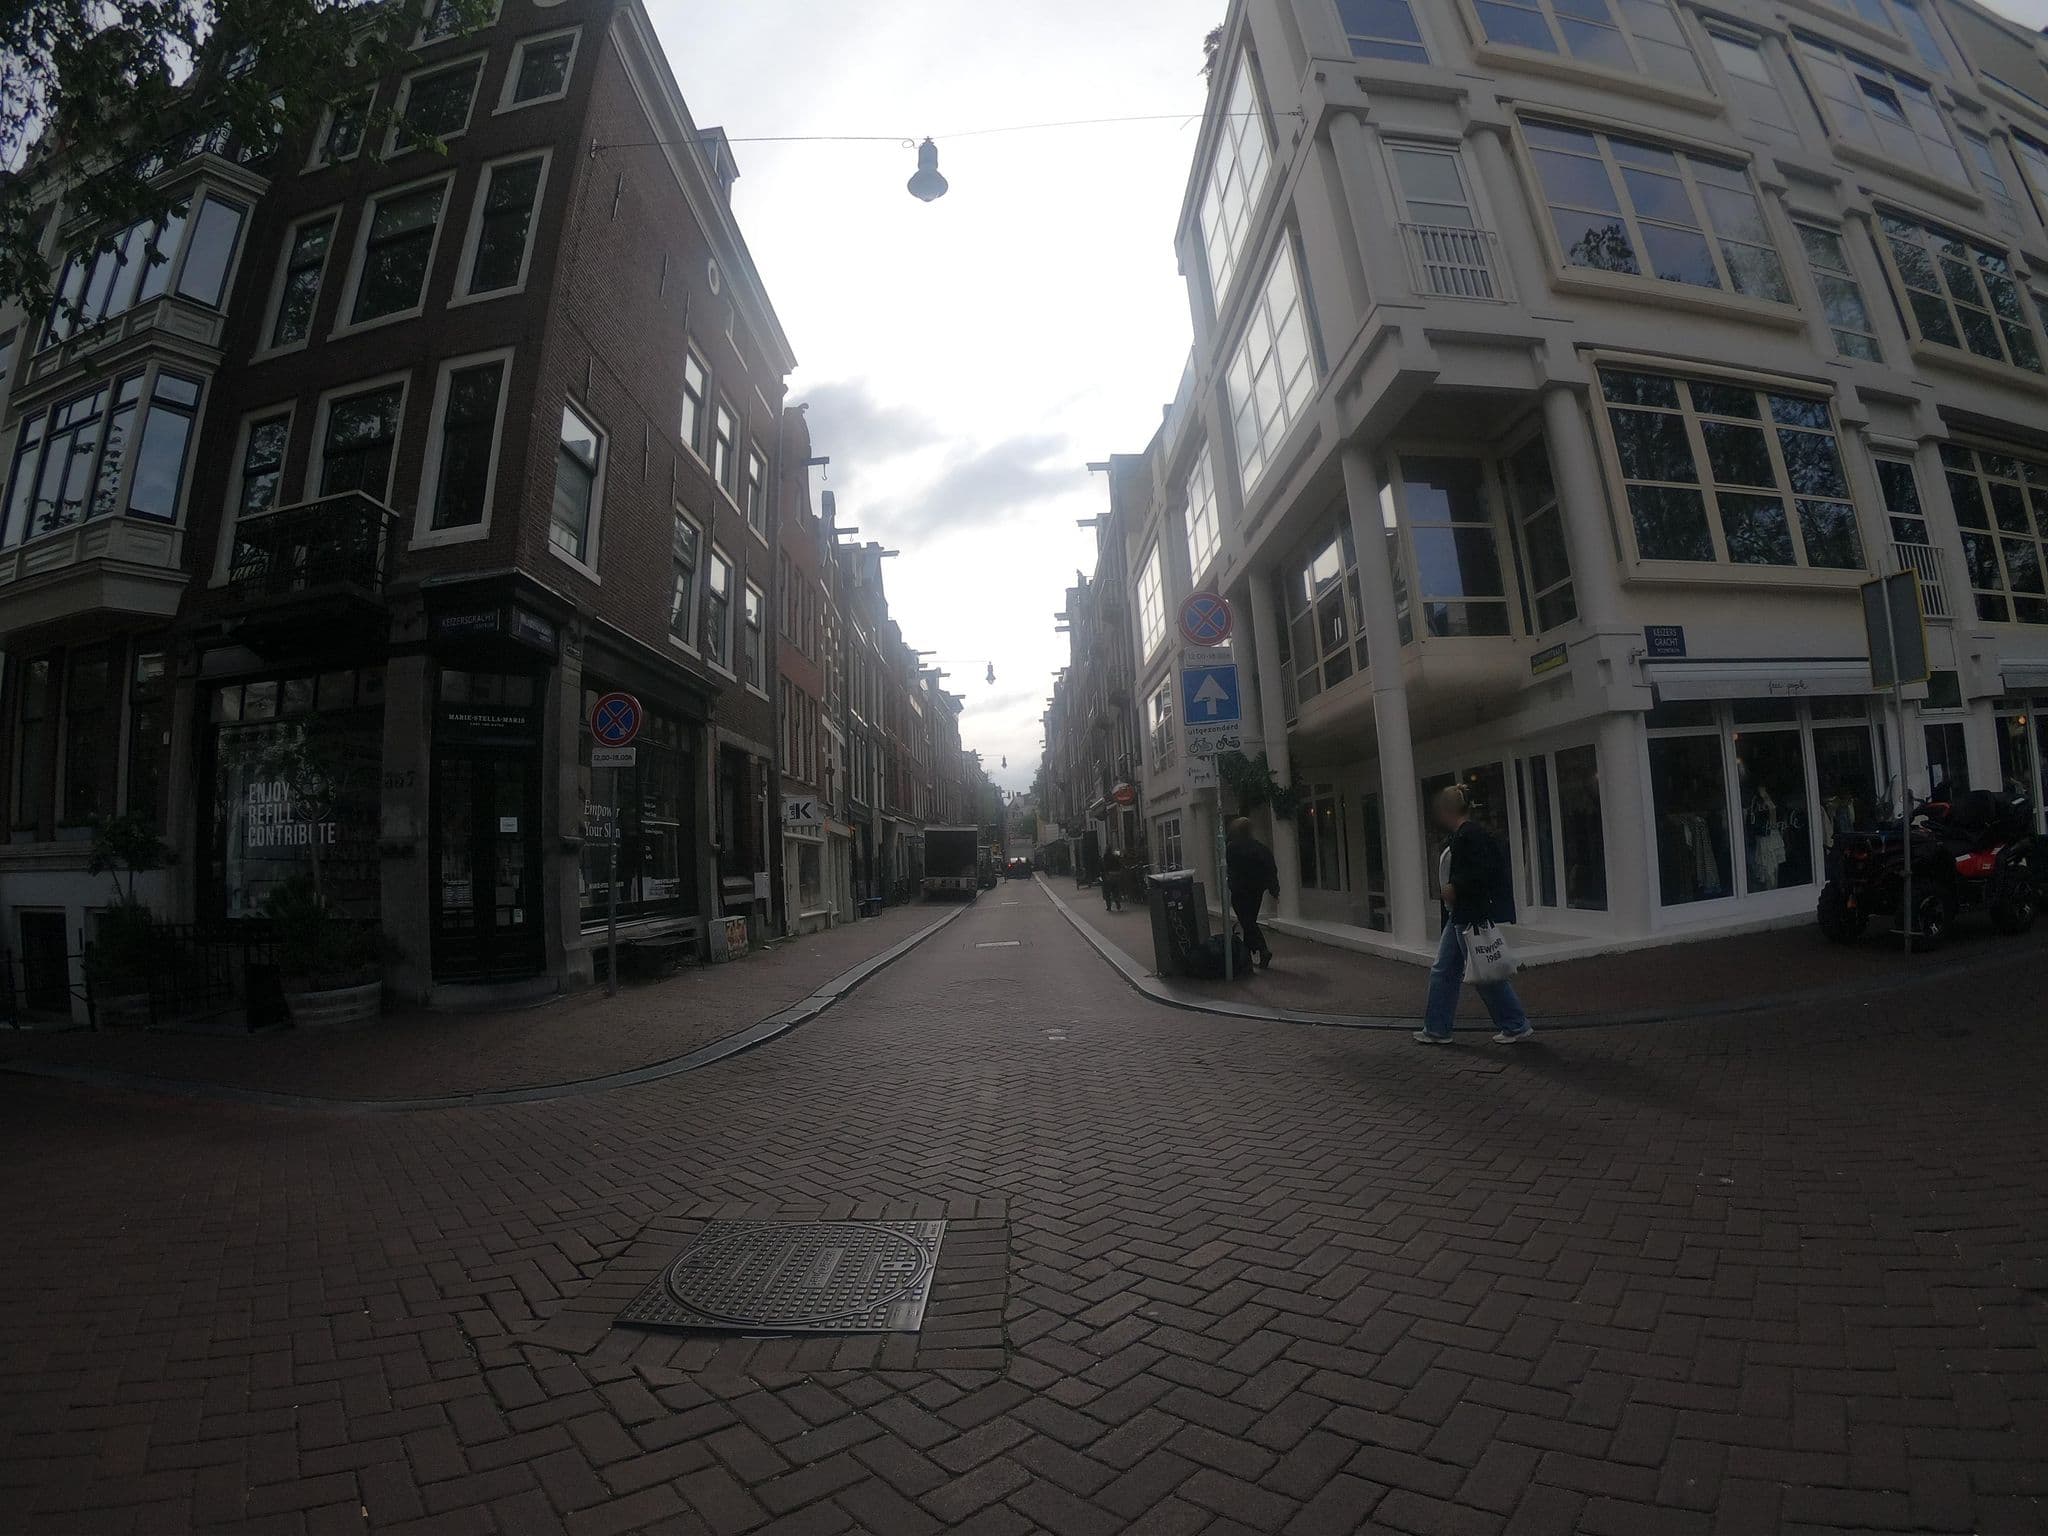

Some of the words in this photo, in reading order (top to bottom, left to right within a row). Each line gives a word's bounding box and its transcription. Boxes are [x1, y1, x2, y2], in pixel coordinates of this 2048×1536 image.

[1653, 628, 1676, 637] KEIZERS
[1655, 638, 1679, 647] GRACHT
[1187, 723, 1239, 736] uitgezonderd
[248, 781, 290, 804] ENJOY
[248, 802, 294, 826] REFILL
[584, 799, 620, 821] Empowr
[584, 821, 603, 837] Your
